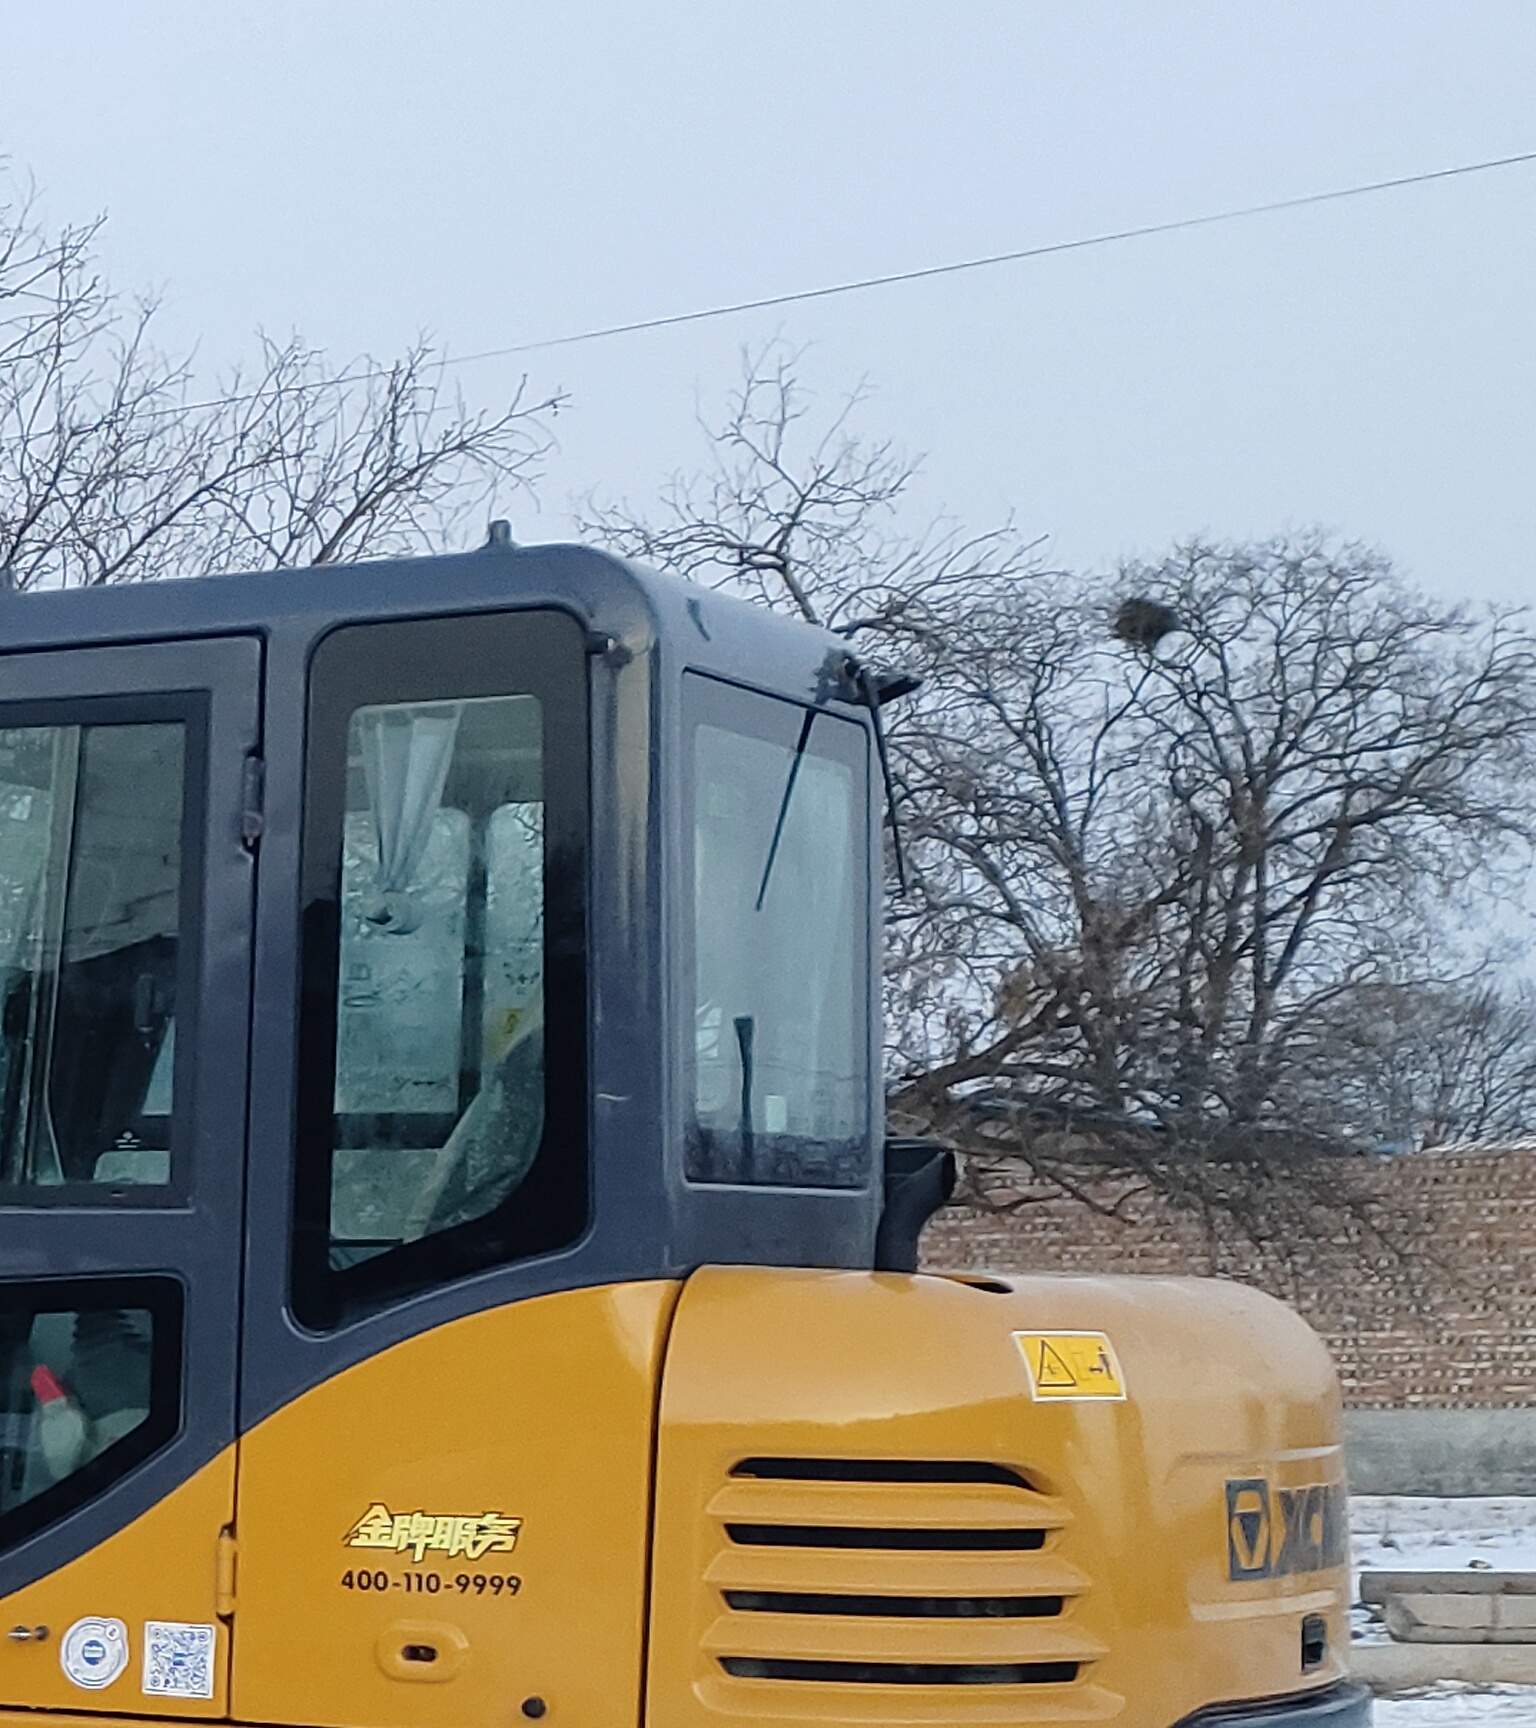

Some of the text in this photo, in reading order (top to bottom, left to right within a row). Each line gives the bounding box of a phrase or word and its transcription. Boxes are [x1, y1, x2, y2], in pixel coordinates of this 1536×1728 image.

[342, 1502, 522, 1563] 金牌服务
[340, 1569, 522, 1597] 400-110-9999
